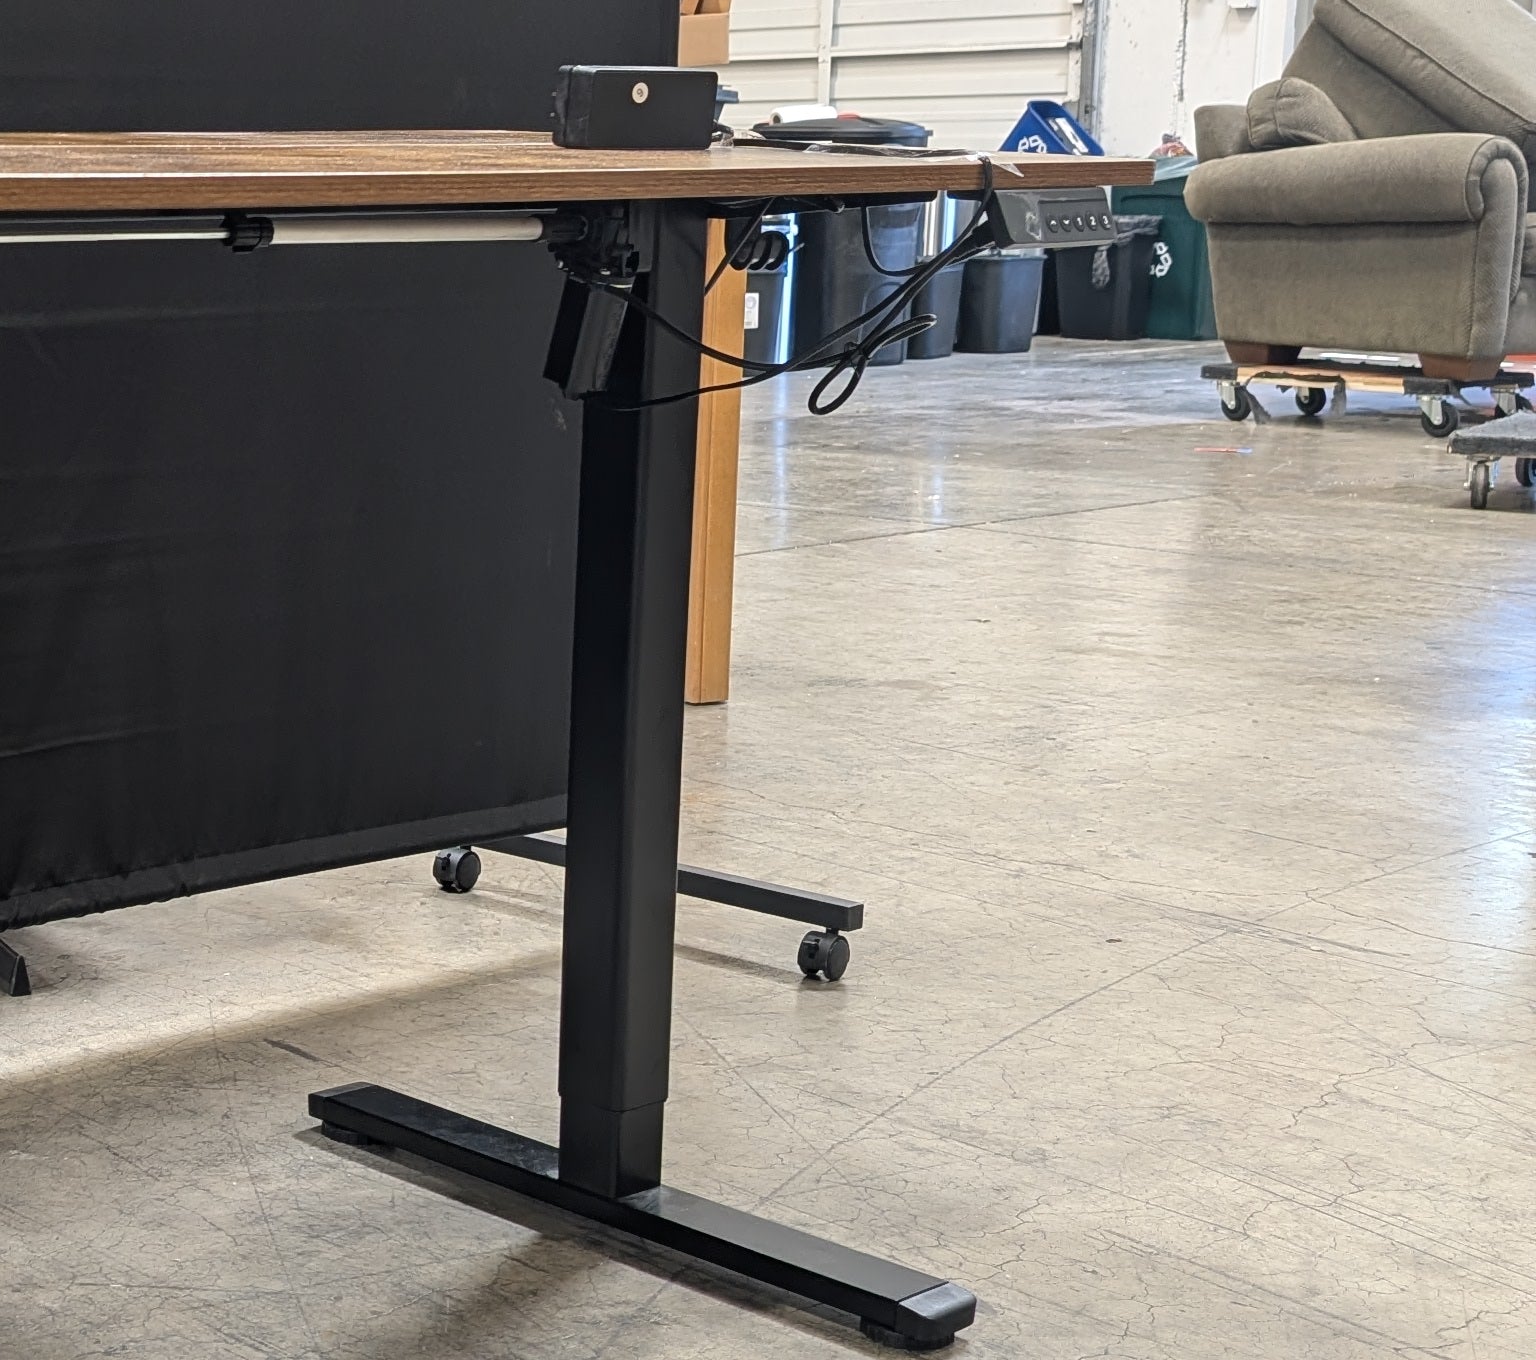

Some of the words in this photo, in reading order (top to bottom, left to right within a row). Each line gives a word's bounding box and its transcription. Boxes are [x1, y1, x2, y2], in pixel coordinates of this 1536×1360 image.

[1077, 217, 1083, 226] 1
[1089, 216, 1097, 226] 2
[1102, 215, 1109, 225] 3
